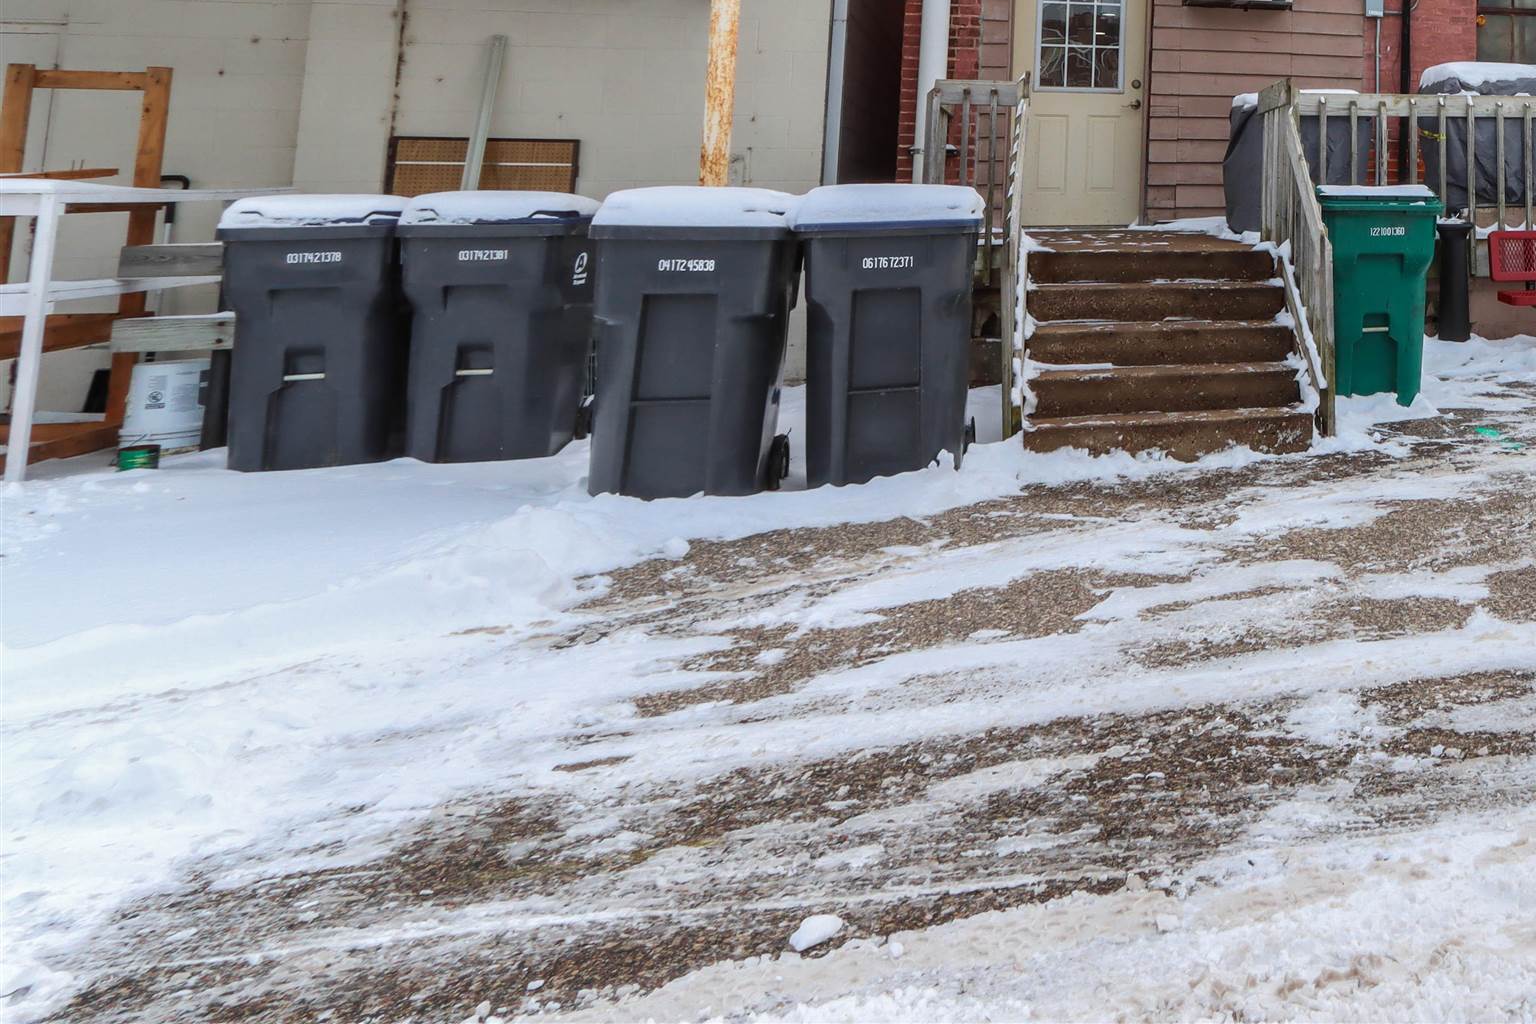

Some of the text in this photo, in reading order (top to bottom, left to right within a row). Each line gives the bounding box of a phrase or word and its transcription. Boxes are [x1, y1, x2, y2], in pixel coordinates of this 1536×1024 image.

[286, 252, 342, 264] 0317421378
[862, 256, 914, 269] 0617672371
[658, 259, 716, 272] 0417245838
